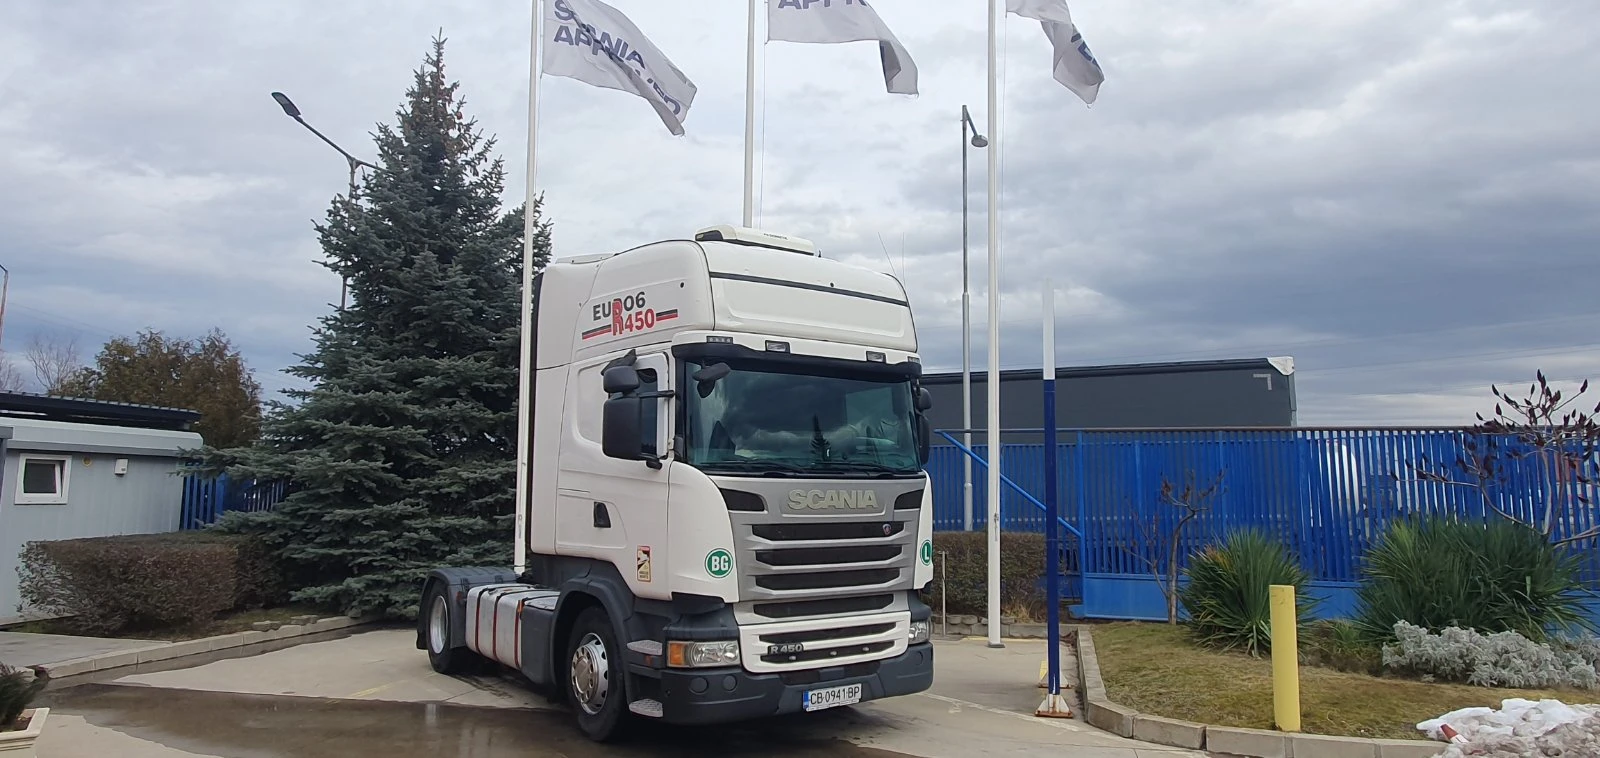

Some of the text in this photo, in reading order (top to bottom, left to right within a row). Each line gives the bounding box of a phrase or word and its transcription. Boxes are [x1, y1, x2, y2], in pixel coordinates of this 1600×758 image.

[554, 0, 645, 69] SNIA
[612, 299, 655, 336] R450
[787, 489, 879, 510] SCANIA
[711, 555, 729, 571] BG
[770, 643, 803, 654] R 450
[825, 689, 847, 703] 0941
[848, 686, 860, 699] BP
